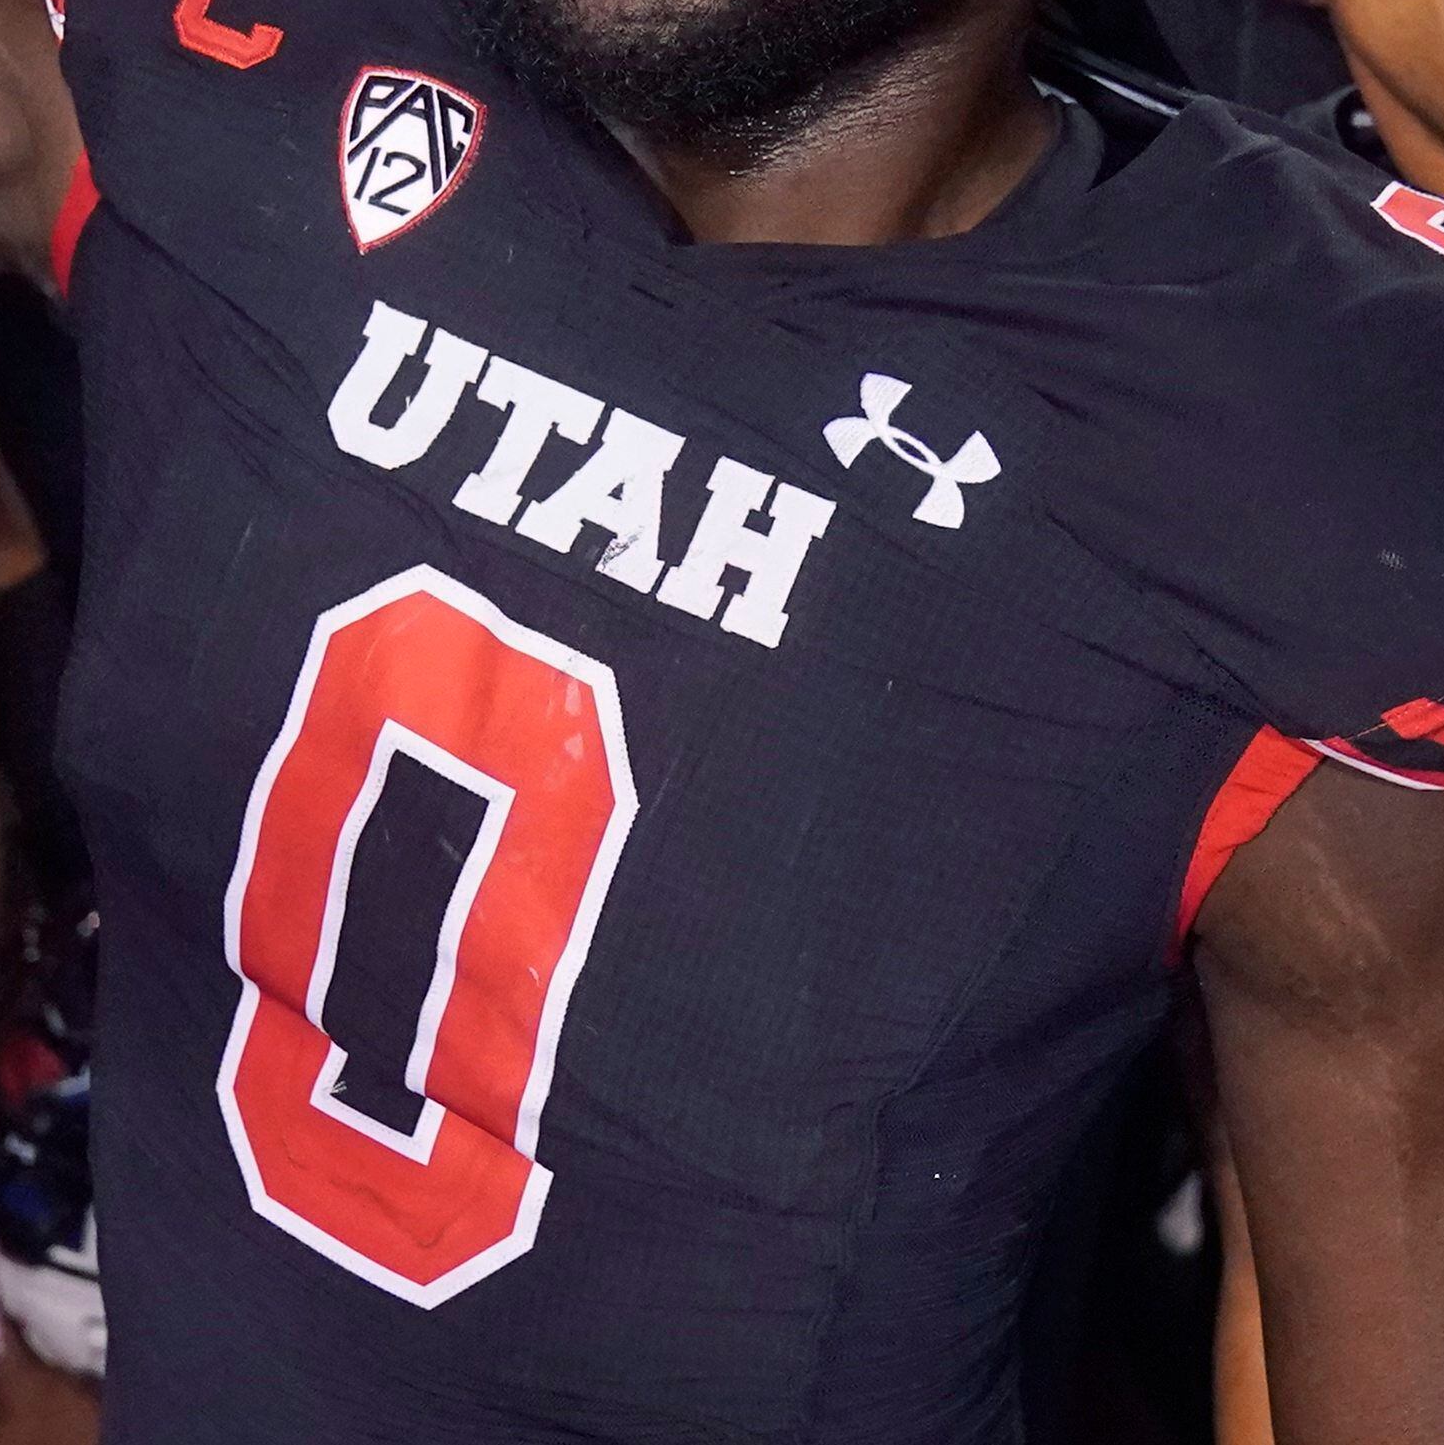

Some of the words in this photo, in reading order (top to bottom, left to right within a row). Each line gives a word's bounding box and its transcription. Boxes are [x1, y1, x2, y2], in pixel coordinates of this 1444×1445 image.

[347, 75, 477, 195] PAC
[353, 146, 427, 216] 12
[326, 300, 836, 649] UTAH
[216, 562, 640, 1310] 0
